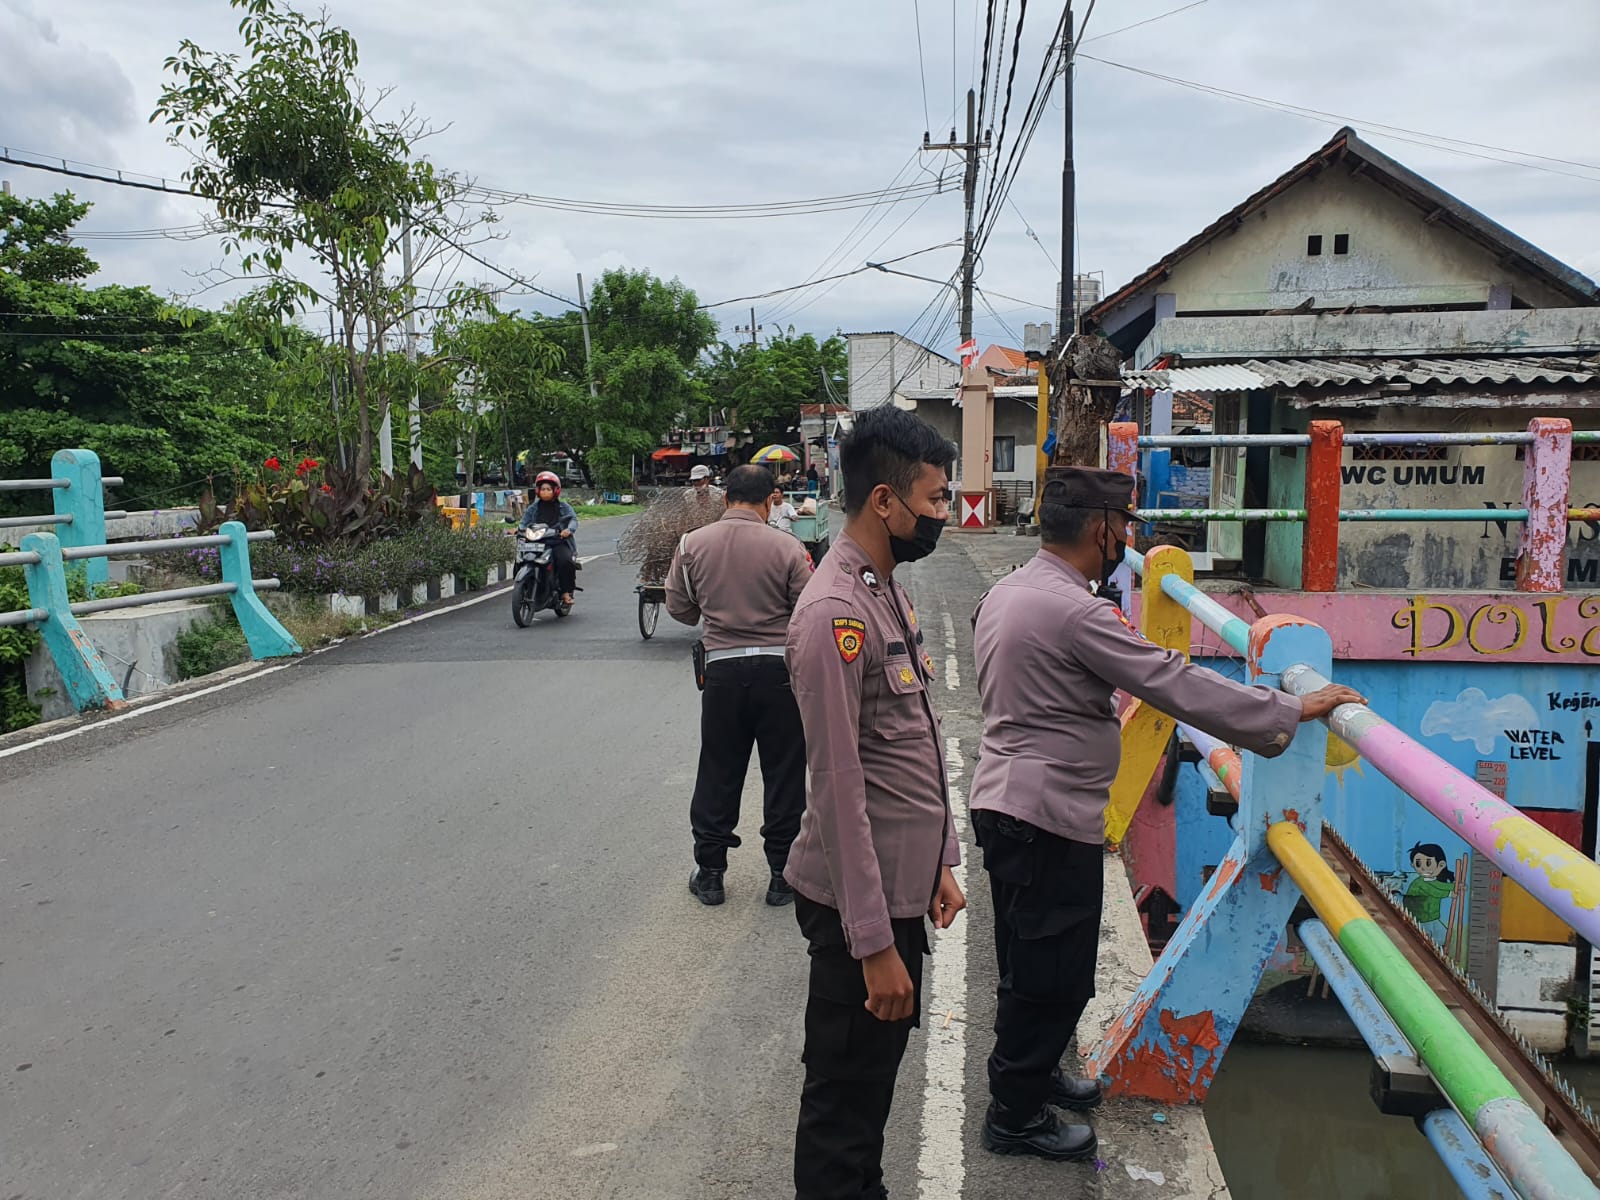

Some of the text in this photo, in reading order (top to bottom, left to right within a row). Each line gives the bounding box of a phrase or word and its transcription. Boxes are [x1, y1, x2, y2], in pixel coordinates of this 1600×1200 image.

[1341, 465, 1485, 485] WC UMUM
[1504, 729, 1565, 745] WATER
[1510, 746, 1562, 760] LEVEL
